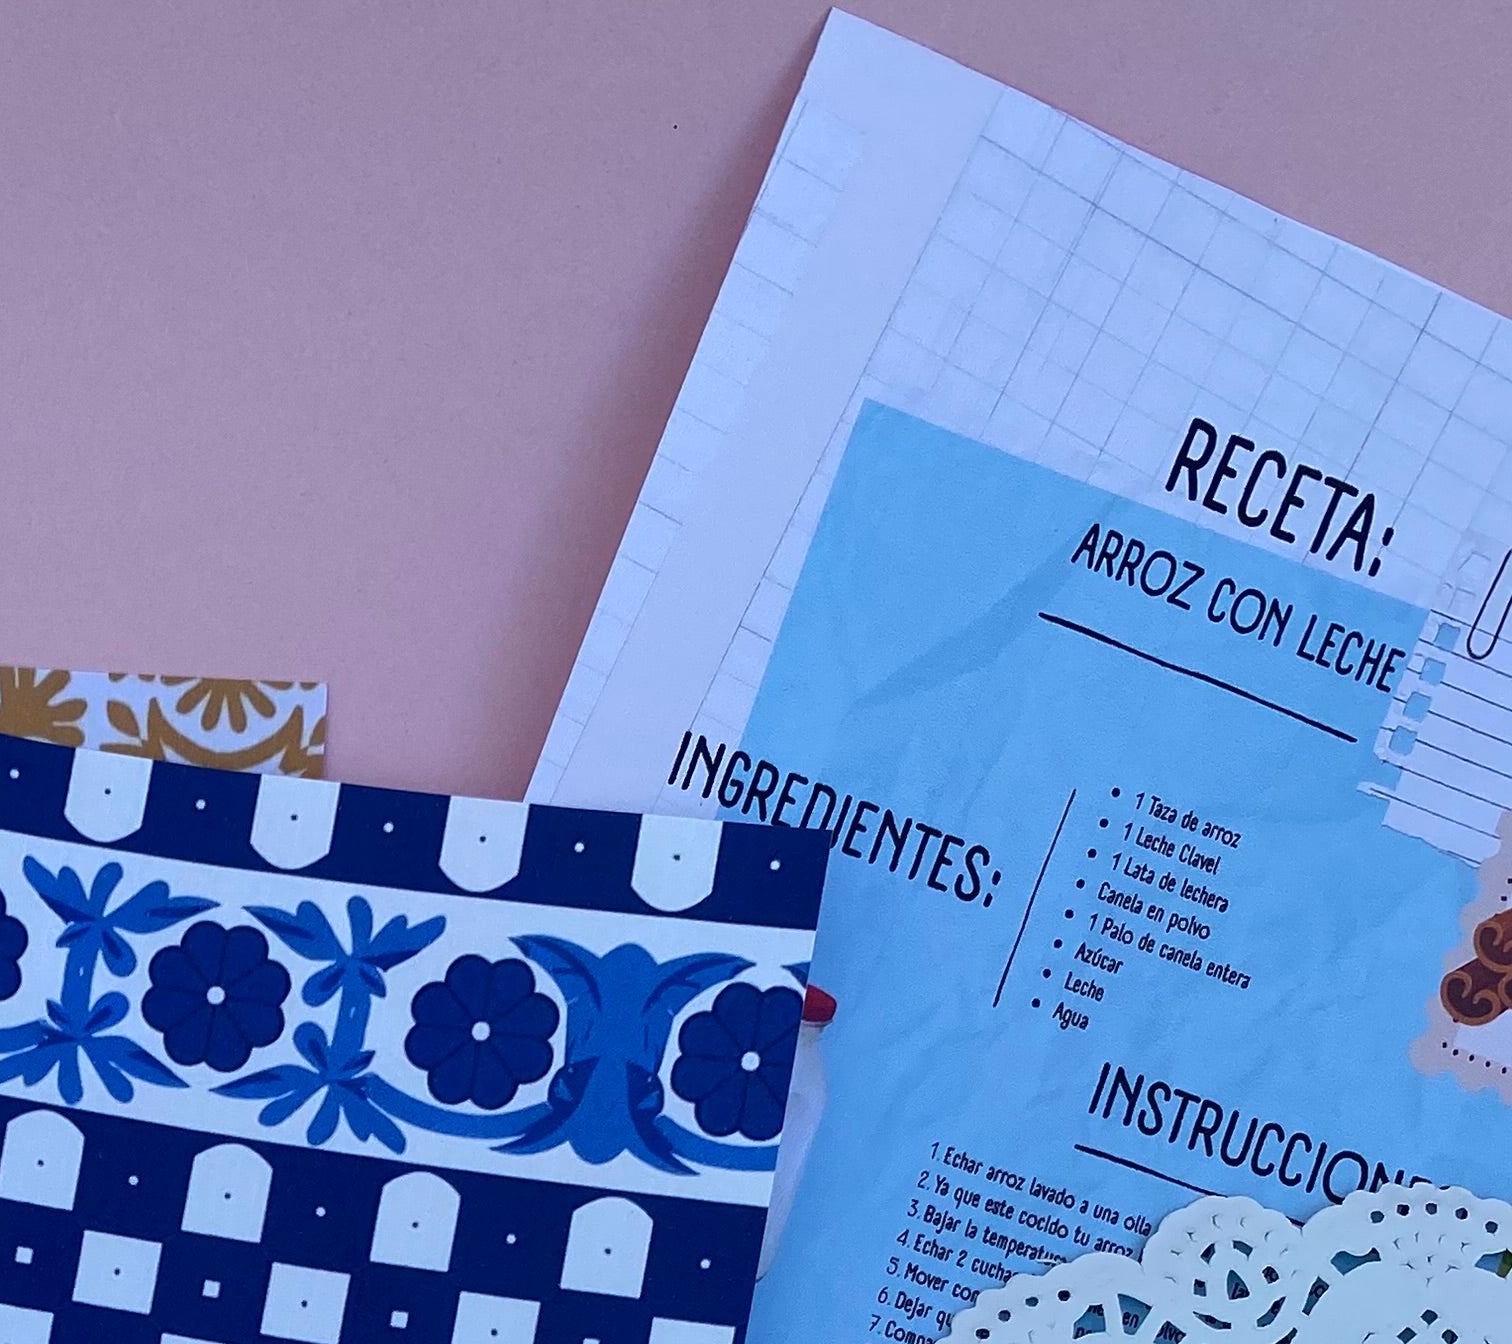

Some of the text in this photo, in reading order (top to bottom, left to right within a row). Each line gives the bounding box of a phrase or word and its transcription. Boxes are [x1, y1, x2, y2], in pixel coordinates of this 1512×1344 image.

[1165, 417, 1394, 577] RECETA:
[1070, 523, 1406, 693] ARROZ CON LECHE
[1148, 795, 1241, 848] Taza de arroz
[1135, 826, 1221, 875] Leche Clavel
[1097, 881, 1210, 939] Canela en polvo
[1123, 856, 1228, 913] Lata de lechera
[1073, 941, 1123, 974] Azúcar
[1100, 917, 1251, 989] Palo de canela entera
[1063, 971, 1104, 1002] Leche
[1052, 1001, 1089, 1030] Agua
[934, 1174, 949, 1196] Ya
[953, 1187, 981, 1211] que
[984, 1198, 1014, 1219] este
[1018, 1210, 1068, 1238] cocido
[1073, 1225, 1090, 1246] tu
[942, 1146, 1152, 1237] Echar arroz lavado una olla
[923, 1204, 978, 1239] Bajar la
[913, 1233, 968, 1268] Echar 2
[903, 1261, 949, 1292] Mover
[894, 1290, 932, 1320] Dejar
